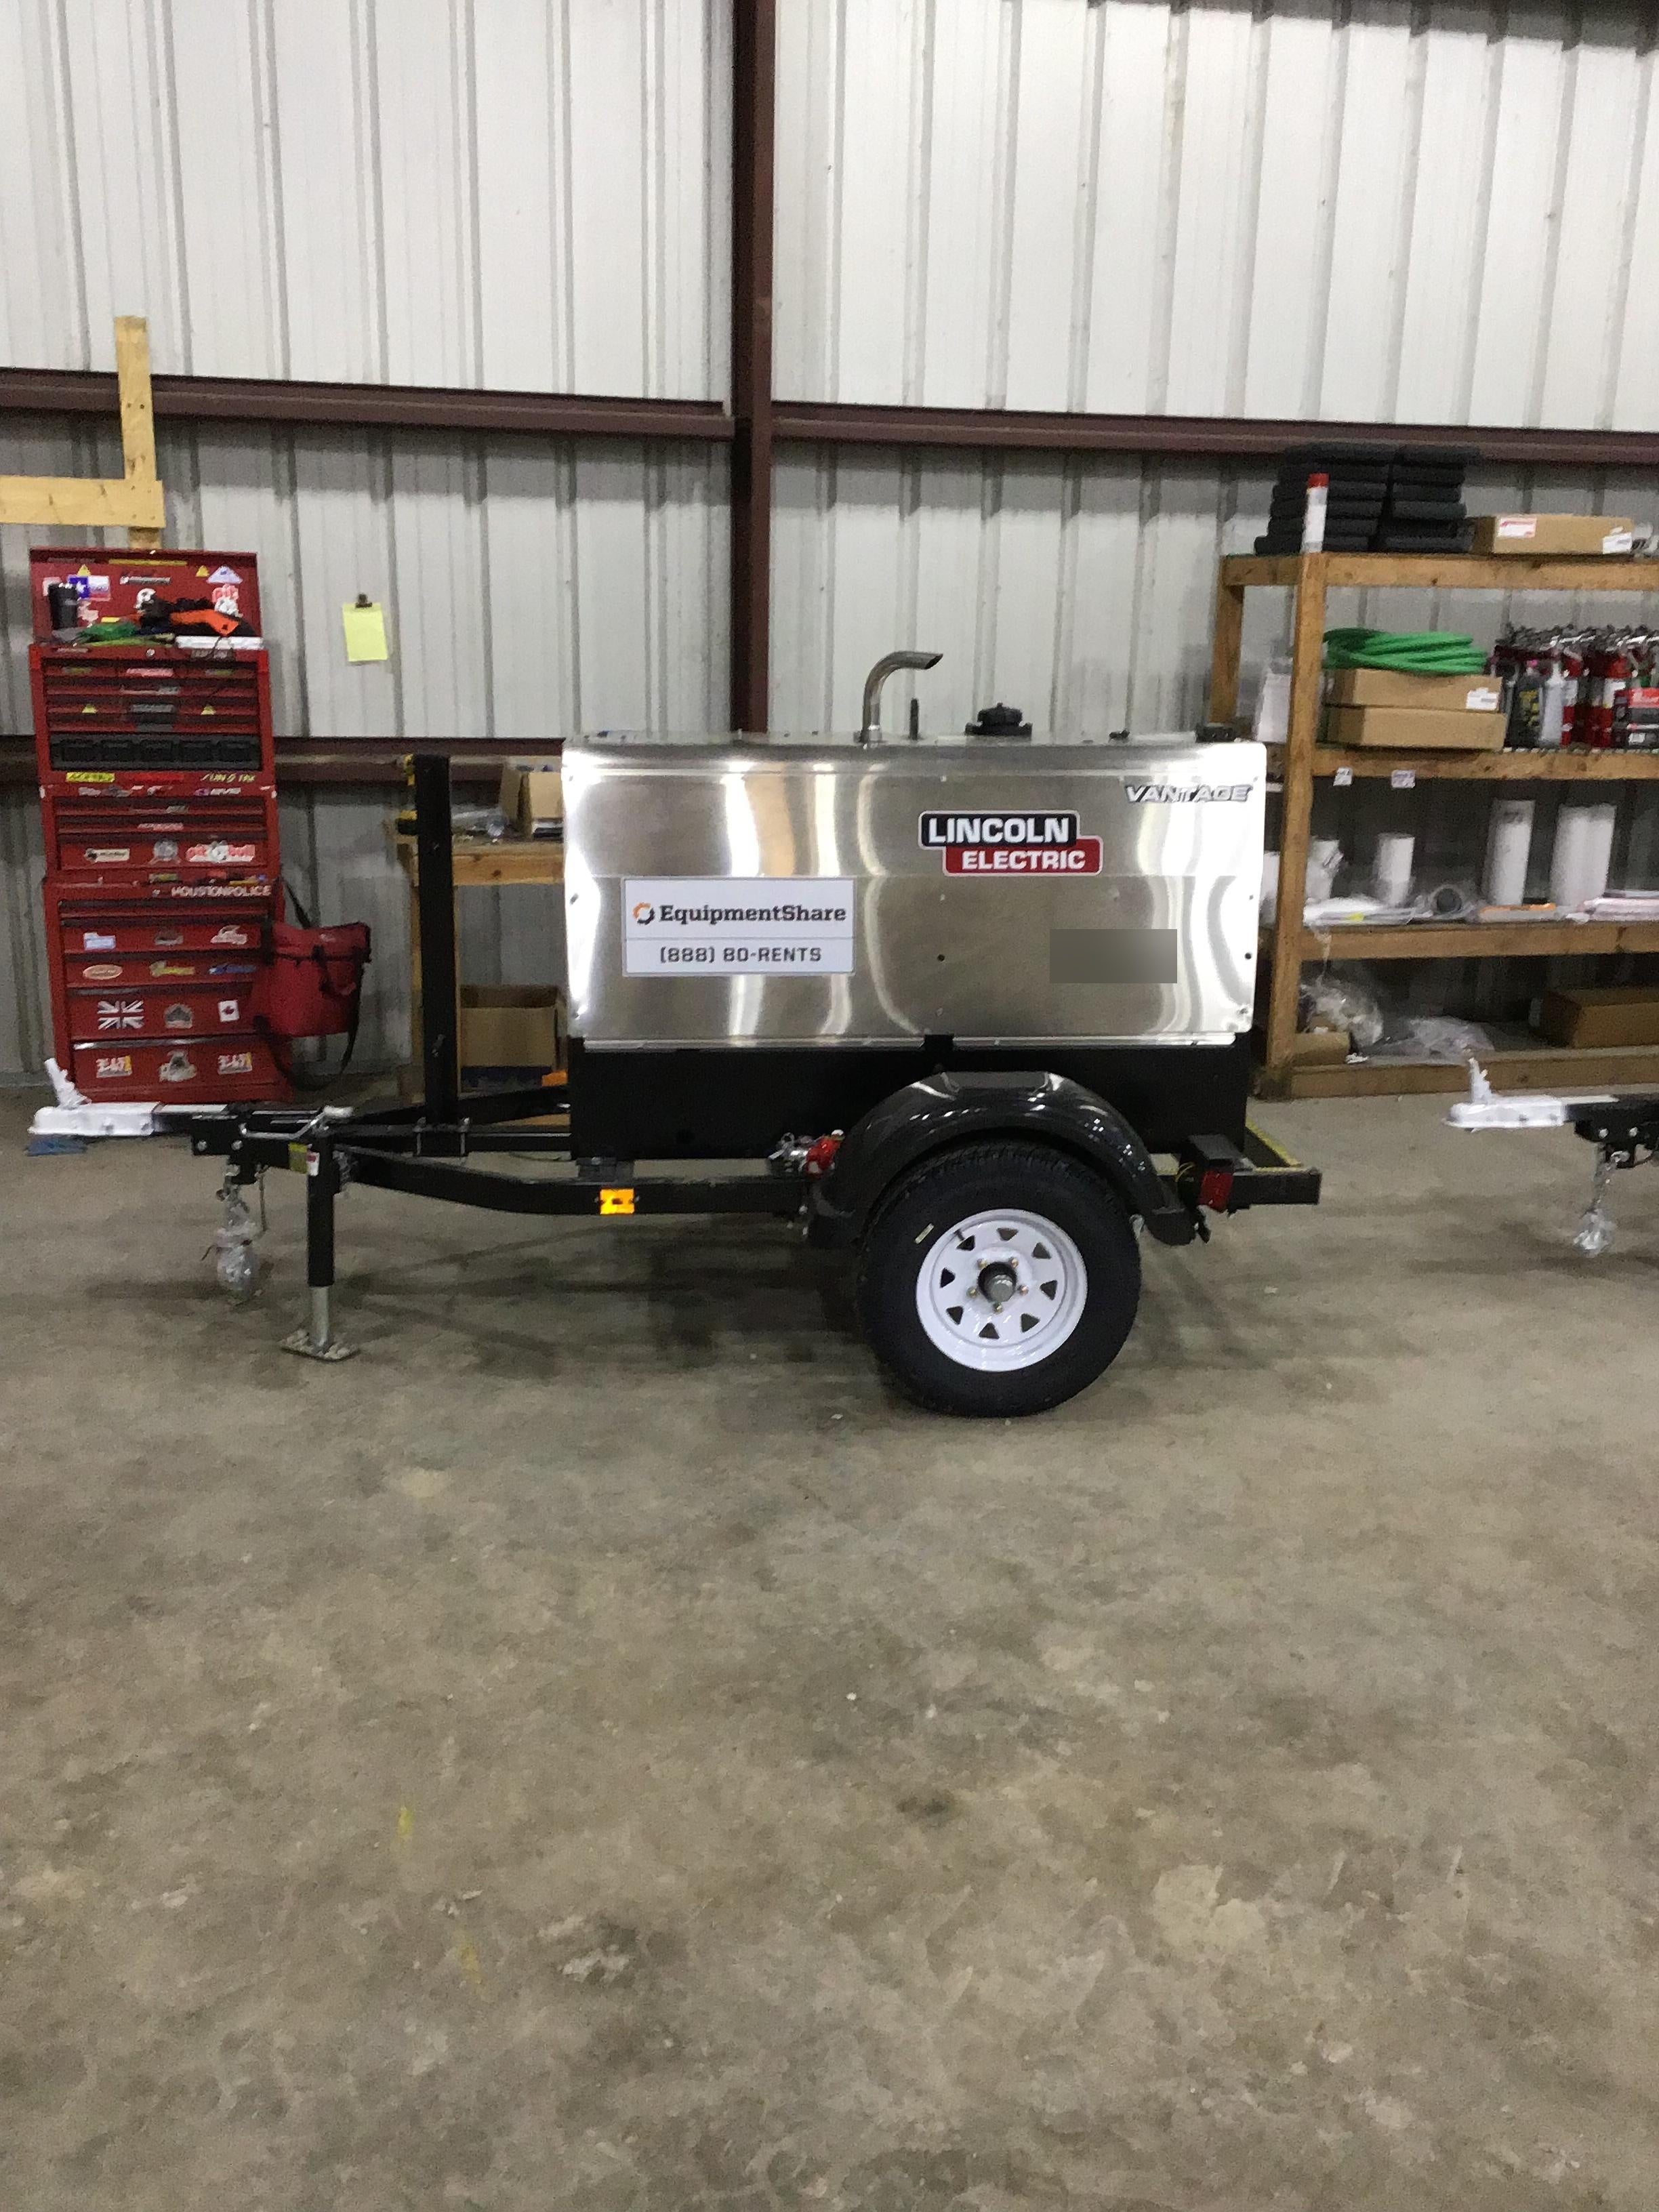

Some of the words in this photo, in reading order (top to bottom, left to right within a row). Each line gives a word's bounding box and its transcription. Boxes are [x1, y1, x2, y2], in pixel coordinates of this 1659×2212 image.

[1125, 784, 1254, 803] VANTAGE
[928, 817, 1069, 844] LINCOLN
[962, 851, 1086, 870] ELECTRIC
[659, 904, 846, 924] EquipmentShare
[660, 947, 715, 963] (888)
[723, 947, 821, 962] 80-RENTS
